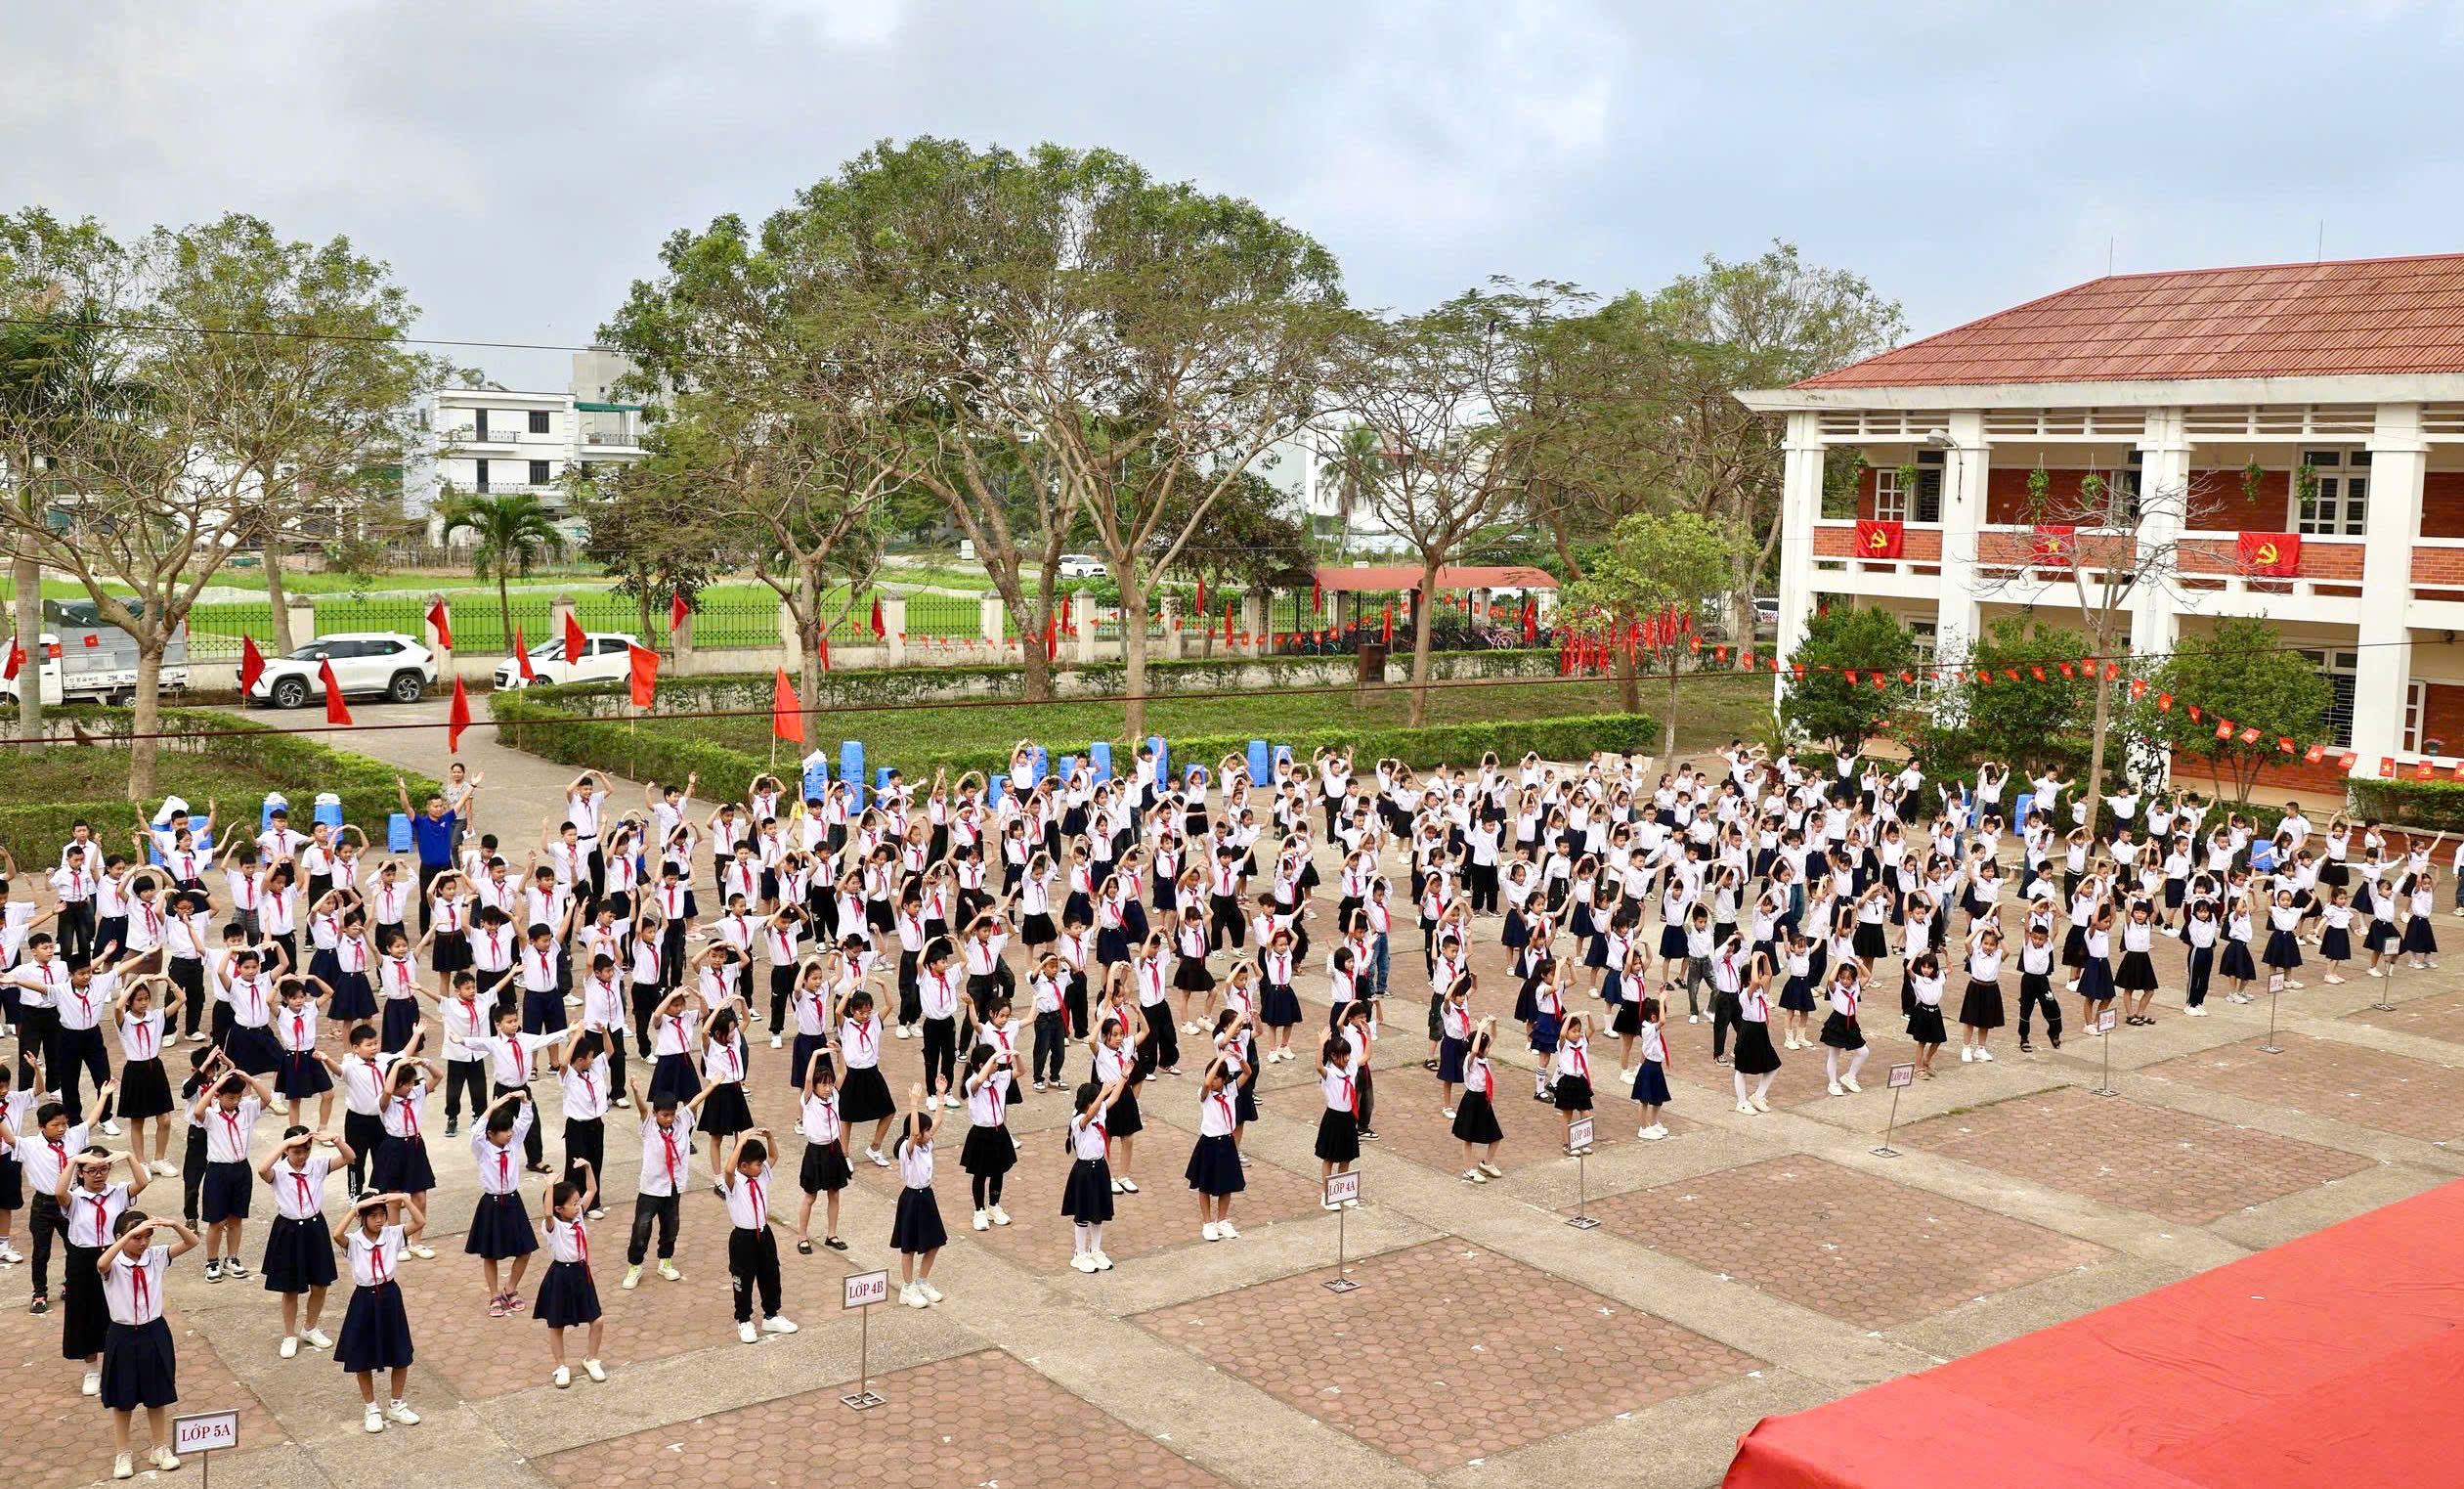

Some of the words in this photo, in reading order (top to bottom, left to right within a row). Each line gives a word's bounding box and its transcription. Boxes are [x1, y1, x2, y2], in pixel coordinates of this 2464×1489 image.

[1571, 1127, 1582, 1143] LỚP
[1583, 1126, 1591, 1138] 3B
[1329, 1180, 1345, 1196] LỚP
[1346, 1181, 1356, 1192] 4A
[848, 1281, 870, 1299] LỚP
[871, 1280, 884, 1294] 4B
[181, 1423, 210, 1442] LỚP
[213, 1423, 231, 1438] 5A
